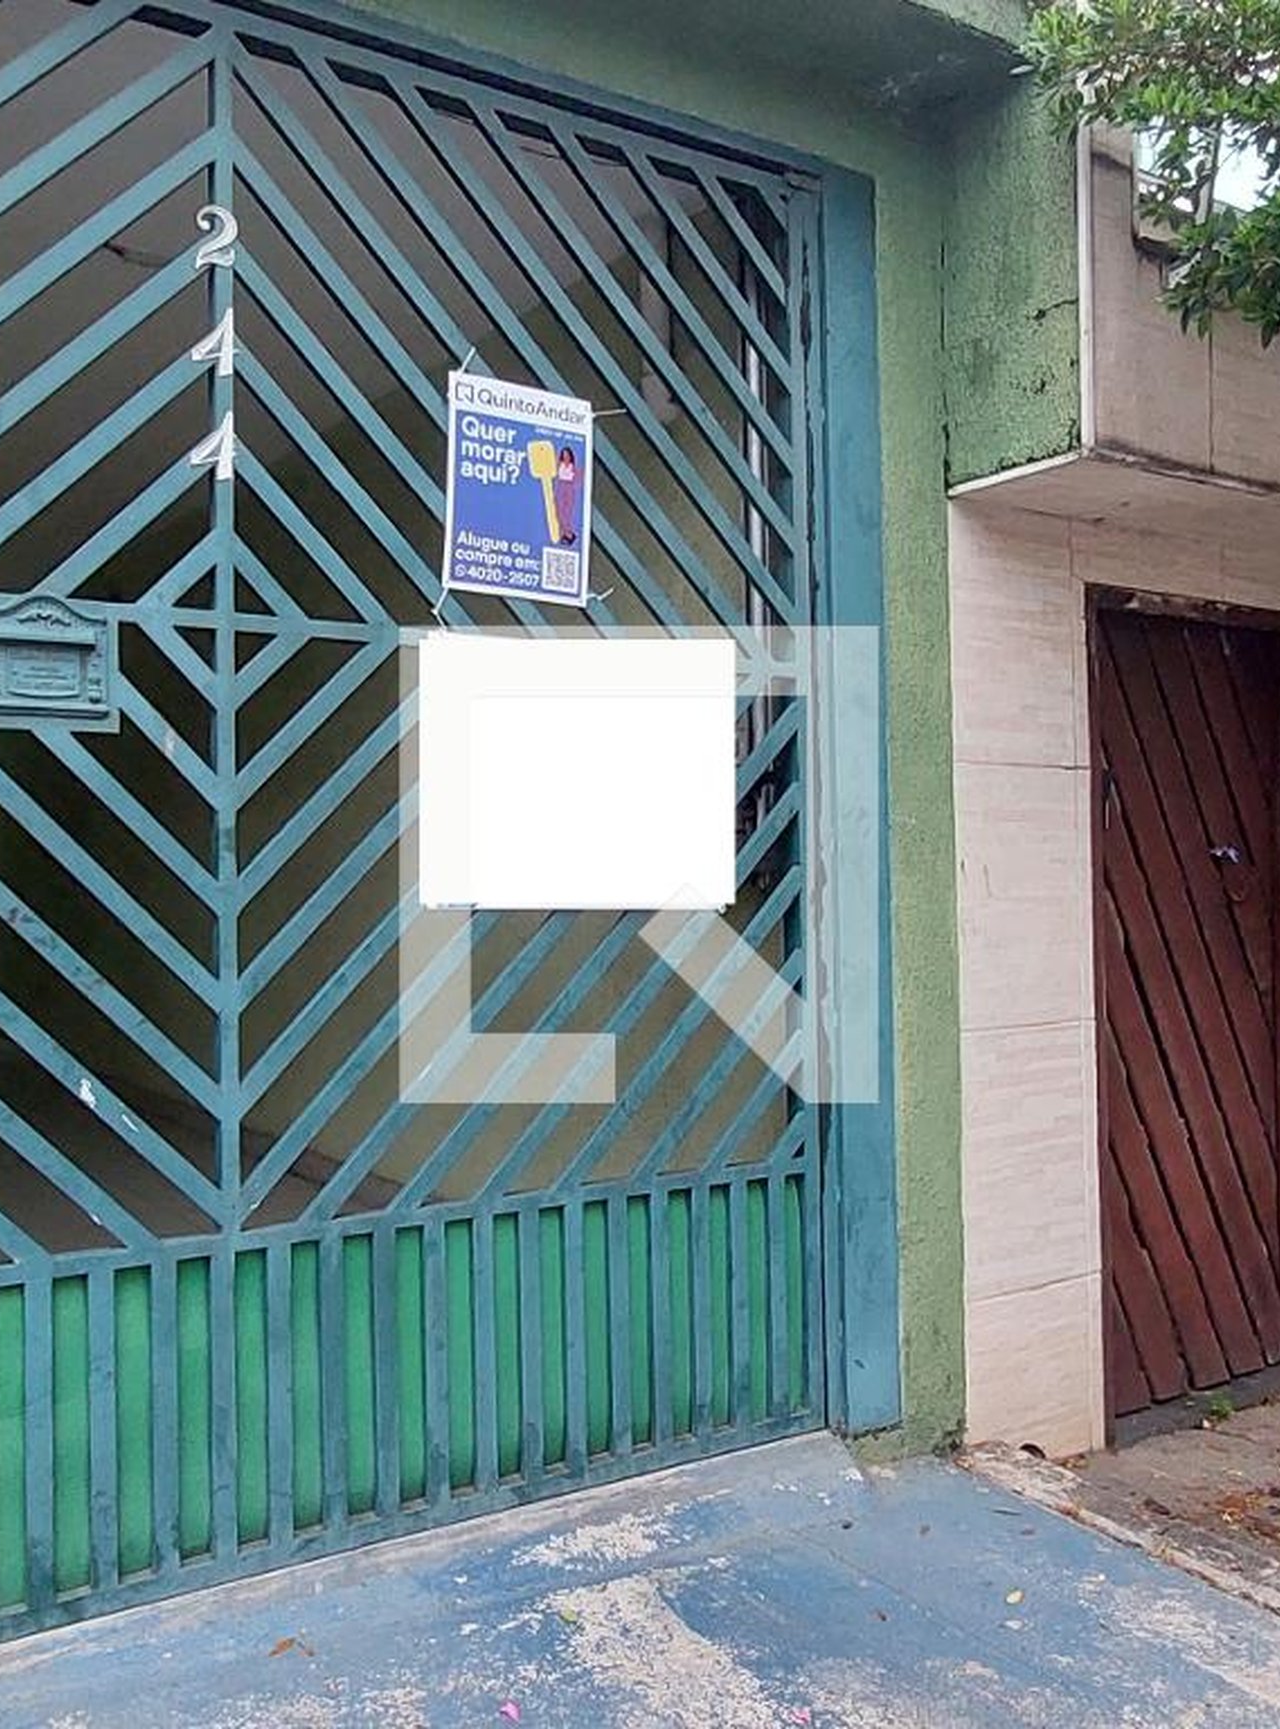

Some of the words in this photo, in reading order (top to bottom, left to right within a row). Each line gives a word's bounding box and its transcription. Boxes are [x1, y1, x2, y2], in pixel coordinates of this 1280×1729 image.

[477, 387, 587, 425] QuintoAndar
[461, 415, 517, 445] Quer
[461, 438, 527, 465] morar
[460, 460, 520, 485] aqui?
[456, 530, 509, 552] Alugue
[511, 541, 532, 555] ou
[455, 548, 512, 569] compre
